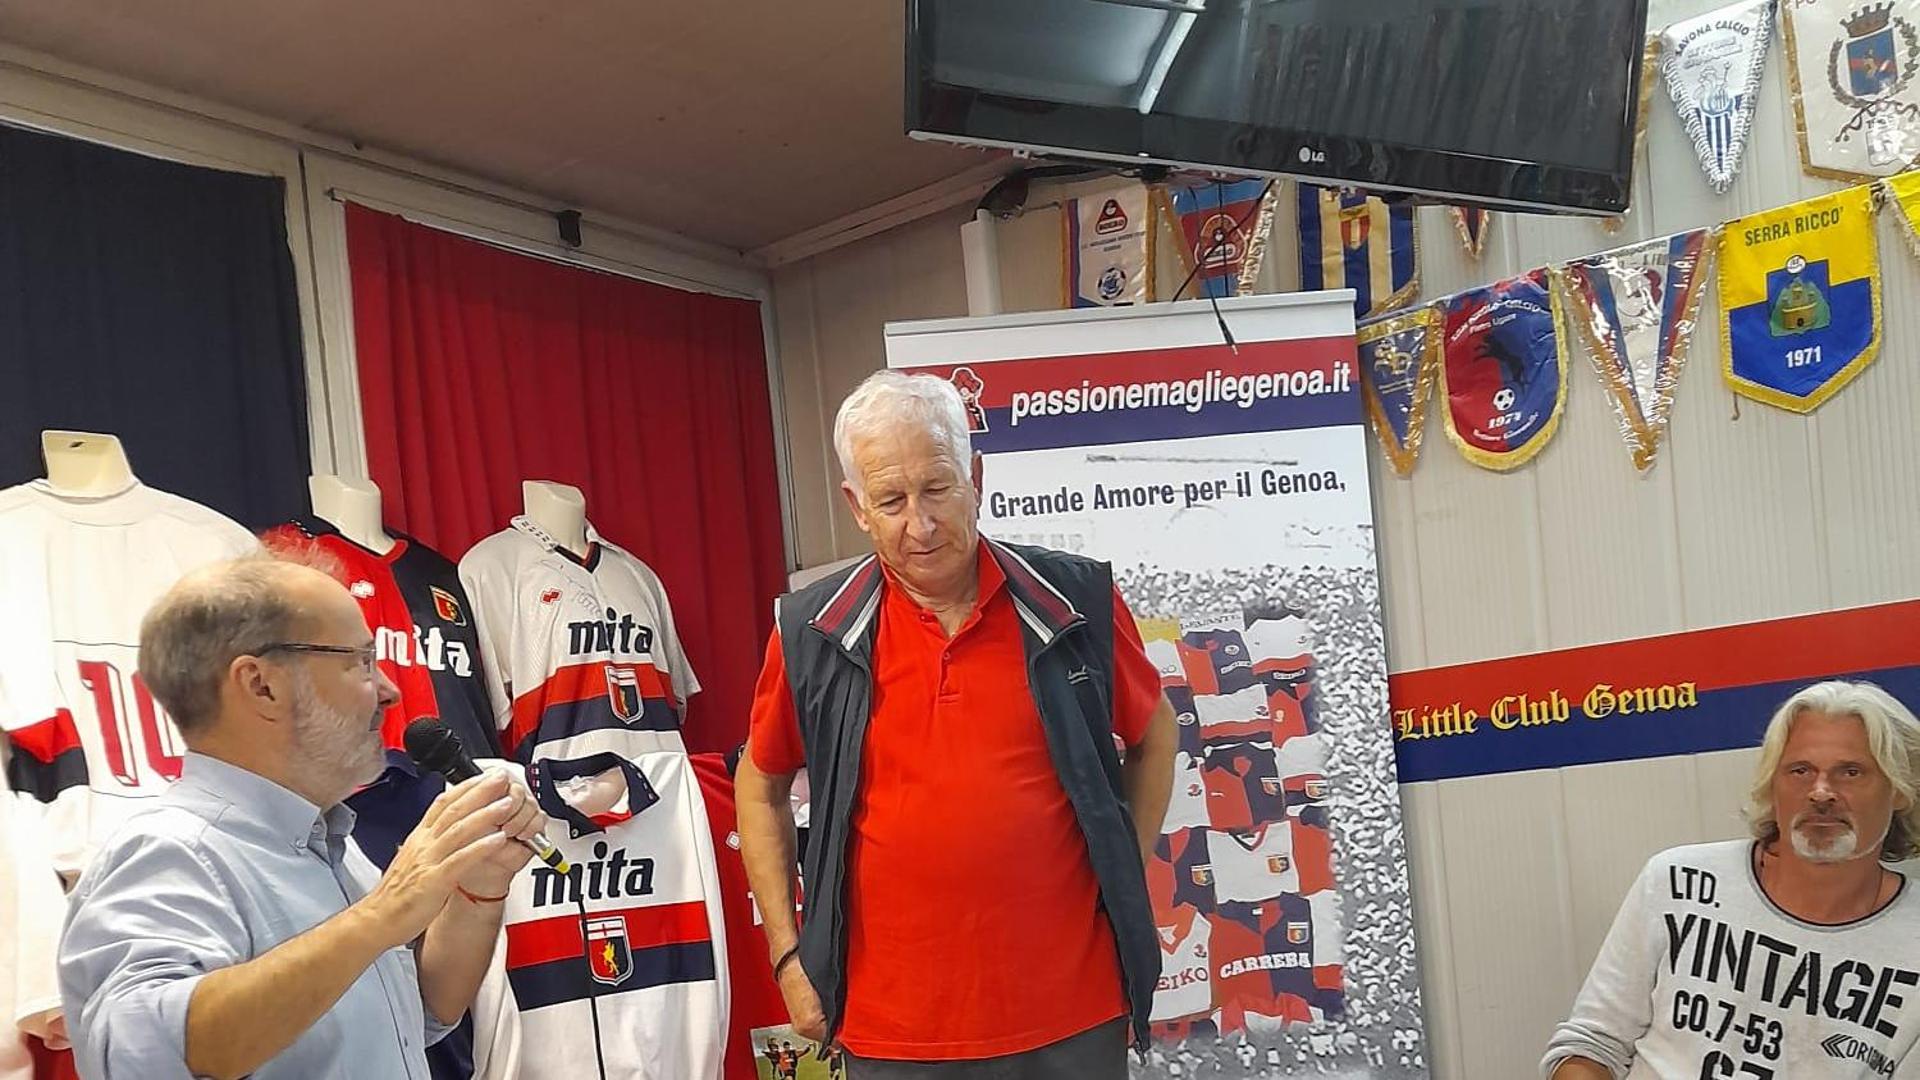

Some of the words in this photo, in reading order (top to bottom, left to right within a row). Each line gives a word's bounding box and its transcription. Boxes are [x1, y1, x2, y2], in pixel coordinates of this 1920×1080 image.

[1715, 20, 1749, 35] CALCIO
[1312, 151, 1325, 162] LG
[1745, 221, 1791, 247] SERRA
[1795, 206, 1844, 234] RICCO'
[1785, 346, 1822, 368] 1971
[1010, 361, 1351, 425] passionemagliegenoa.it
[990, 486, 1084, 518] Grande
[1093, 482, 1175, 510] Amore
[1184, 477, 1227, 507] per
[1236, 471, 1251, 498] il
[1261, 468, 1346, 497] Genoa,
[376, 625, 472, 678] mita
[568, 606, 652, 655] mita
[1395, 703, 1478, 742] Little
[1490, 689, 1570, 730] Club
[1582, 682, 1698, 720] Genoa
[530, 840, 655, 908] mita
[1670, 865, 1720, 908] LTD.
[1664, 913, 1919, 1039] VINTAGE
[1673, 990, 1783, 1060] CO.7-53
